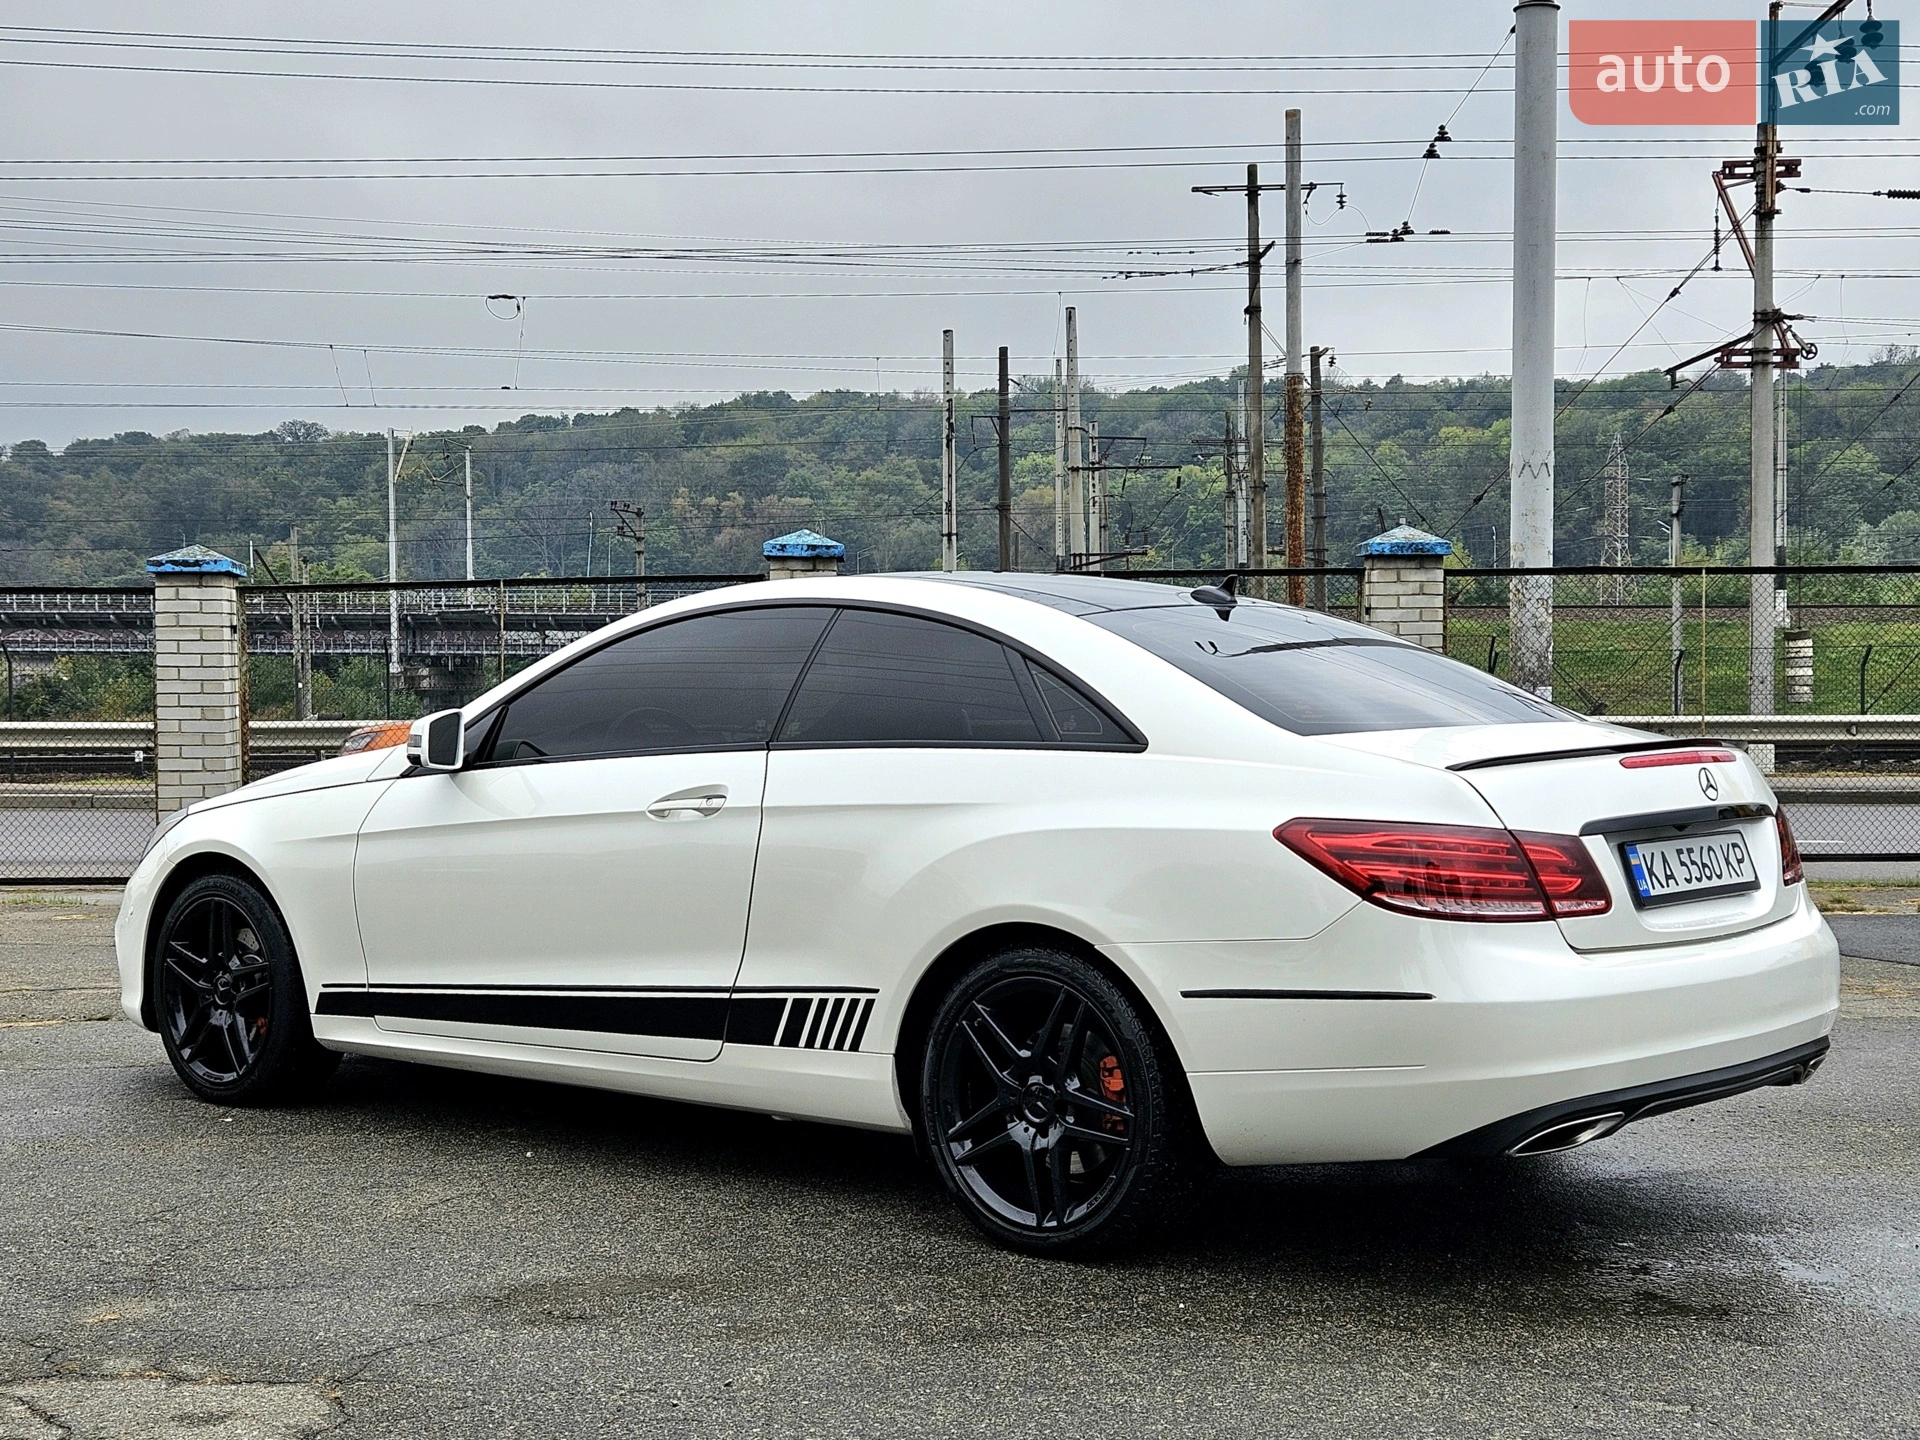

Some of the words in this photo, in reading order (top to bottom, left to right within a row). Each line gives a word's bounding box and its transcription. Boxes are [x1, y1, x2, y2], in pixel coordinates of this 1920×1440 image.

[1642, 850, 1679, 890] KA
[1676, 845, 1723, 884] 5560
[1720, 842, 1745, 878] KP
[1637, 879, 1648, 891] UA
